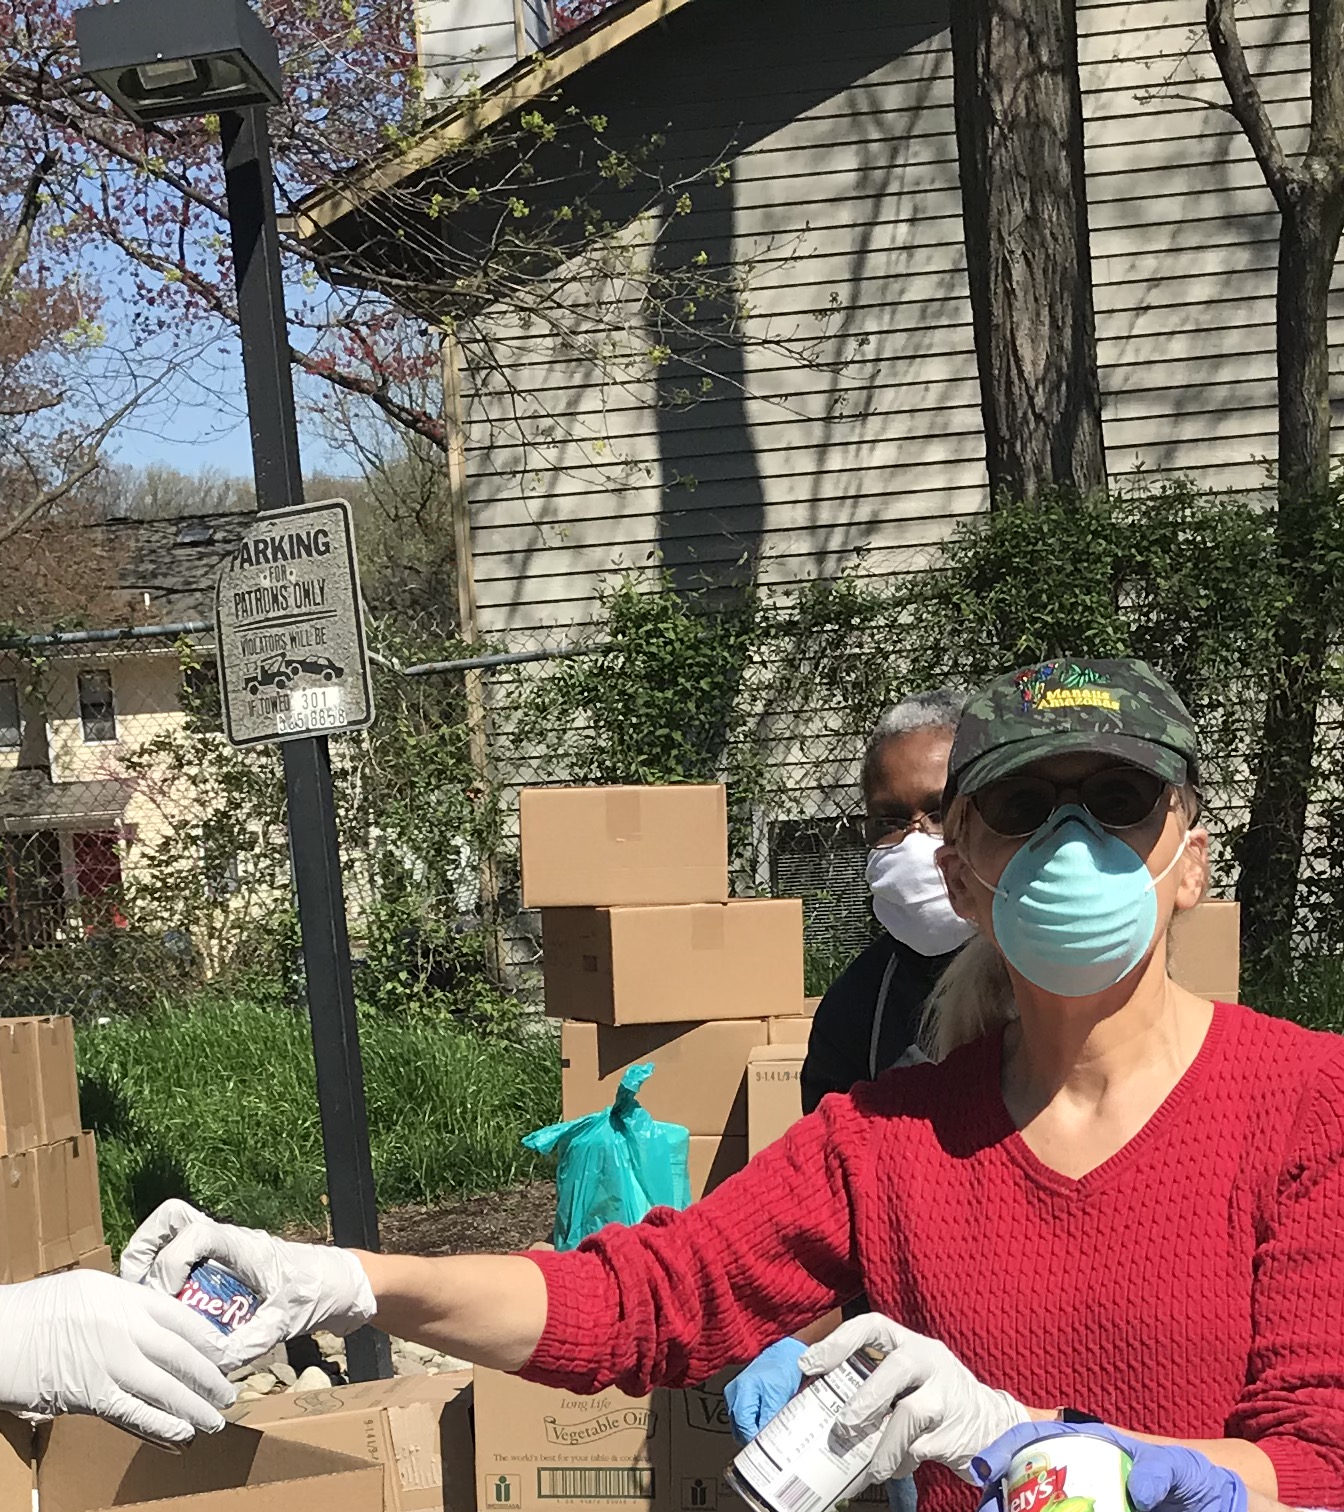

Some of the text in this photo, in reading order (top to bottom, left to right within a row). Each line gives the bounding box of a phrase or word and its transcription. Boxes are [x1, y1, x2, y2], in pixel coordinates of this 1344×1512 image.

[229, 529, 331, 572] PARKING
[268, 564, 288, 583] FOR
[234, 579, 326, 619] PATRONS ONLY
[241, 627, 327, 657] VIOLATORS WILL BE
[302, 691, 327, 710] 301
[1046, 688, 1111, 700] Manaus
[259, 693, 290, 715] TOWED
[1037, 697, 1121, 711] Amazonas
[561, 1397, 613, 1411] Long Life
[552, 1411, 648, 1445] Vegetable Oil
[493, 1453, 507, 1462] The
[510, 1453, 539, 1462] world's
[540, 1454, 557, 1462] best
[557, 1453, 569, 1462] for
[570, 1455, 589, 1465] your
